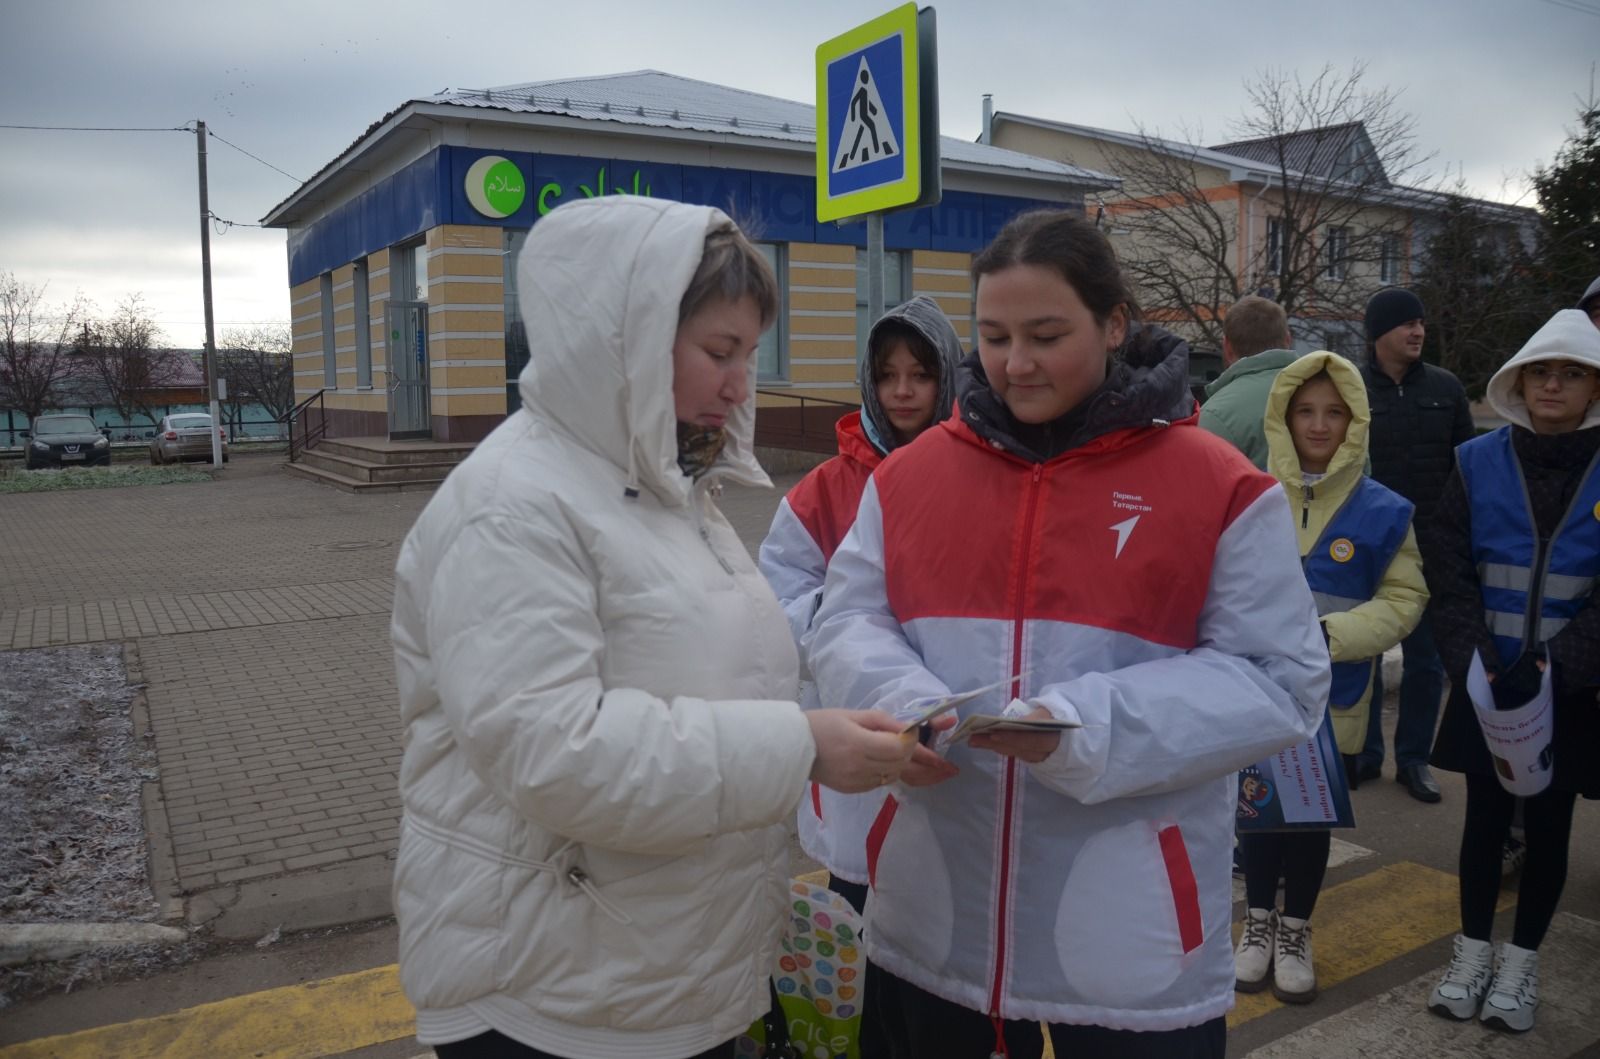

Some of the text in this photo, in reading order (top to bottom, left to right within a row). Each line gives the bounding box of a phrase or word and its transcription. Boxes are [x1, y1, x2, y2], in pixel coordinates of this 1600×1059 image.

[487, 175, 521, 197] سلام
[1112, 500, 1152, 512] Татарстан
[788, 1018, 850, 1053] rice
